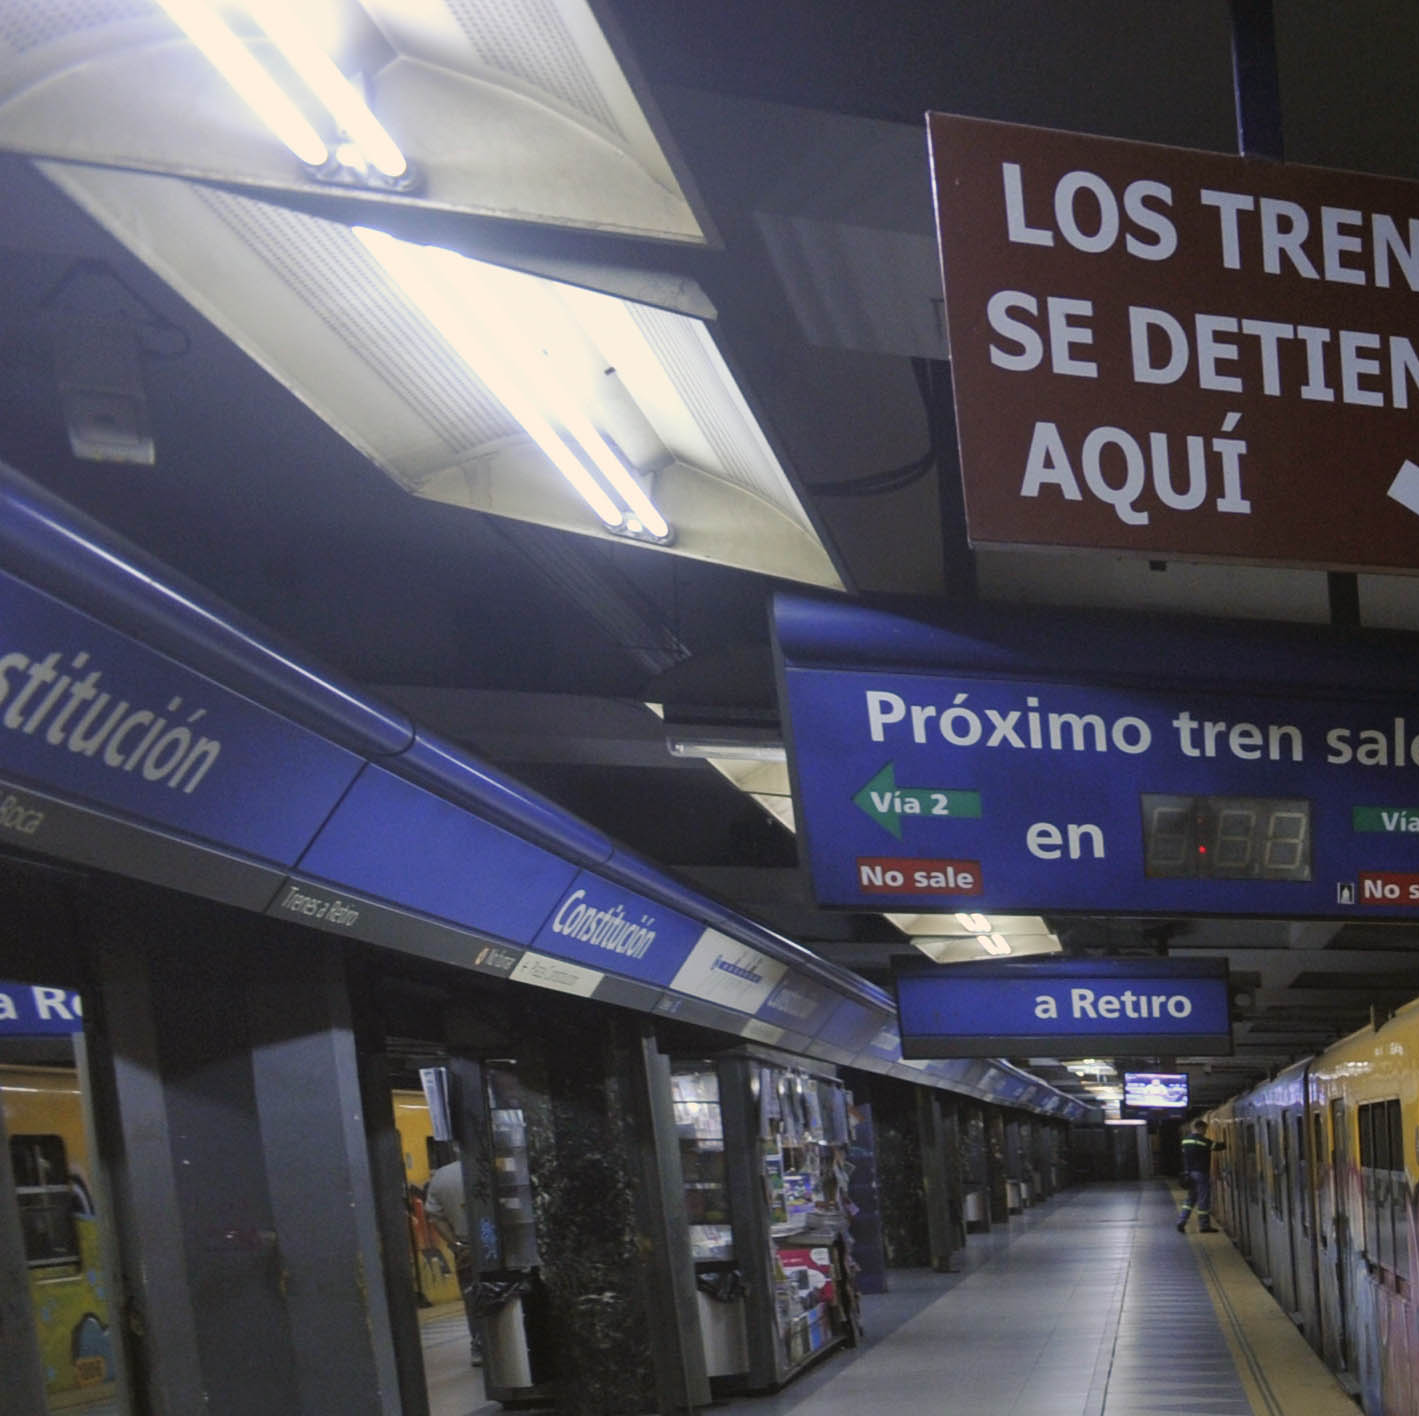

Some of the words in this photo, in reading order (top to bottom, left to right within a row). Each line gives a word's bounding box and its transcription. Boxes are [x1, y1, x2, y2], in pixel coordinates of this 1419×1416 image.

[1002, 162, 1178, 261] LOS
[986, 291, 1098, 378] SE
[1020, 412, 1252, 525] AQUÍ
[865, 690, 1152, 755] Próximo
[1172, 709, 1304, 764] tren
[870, 791, 921, 814] Vía
[930, 793, 950, 815] 2
[1026, 820, 1106, 860] en
[860, 865, 905, 887] No
[913, 866, 974, 889] sale
[1363, 879, 1401, 899] No
[552, 888, 657, 960] Constitución
[1033, 993, 1060, 1019] a
[1071, 987, 1193, 1021] Retiro
